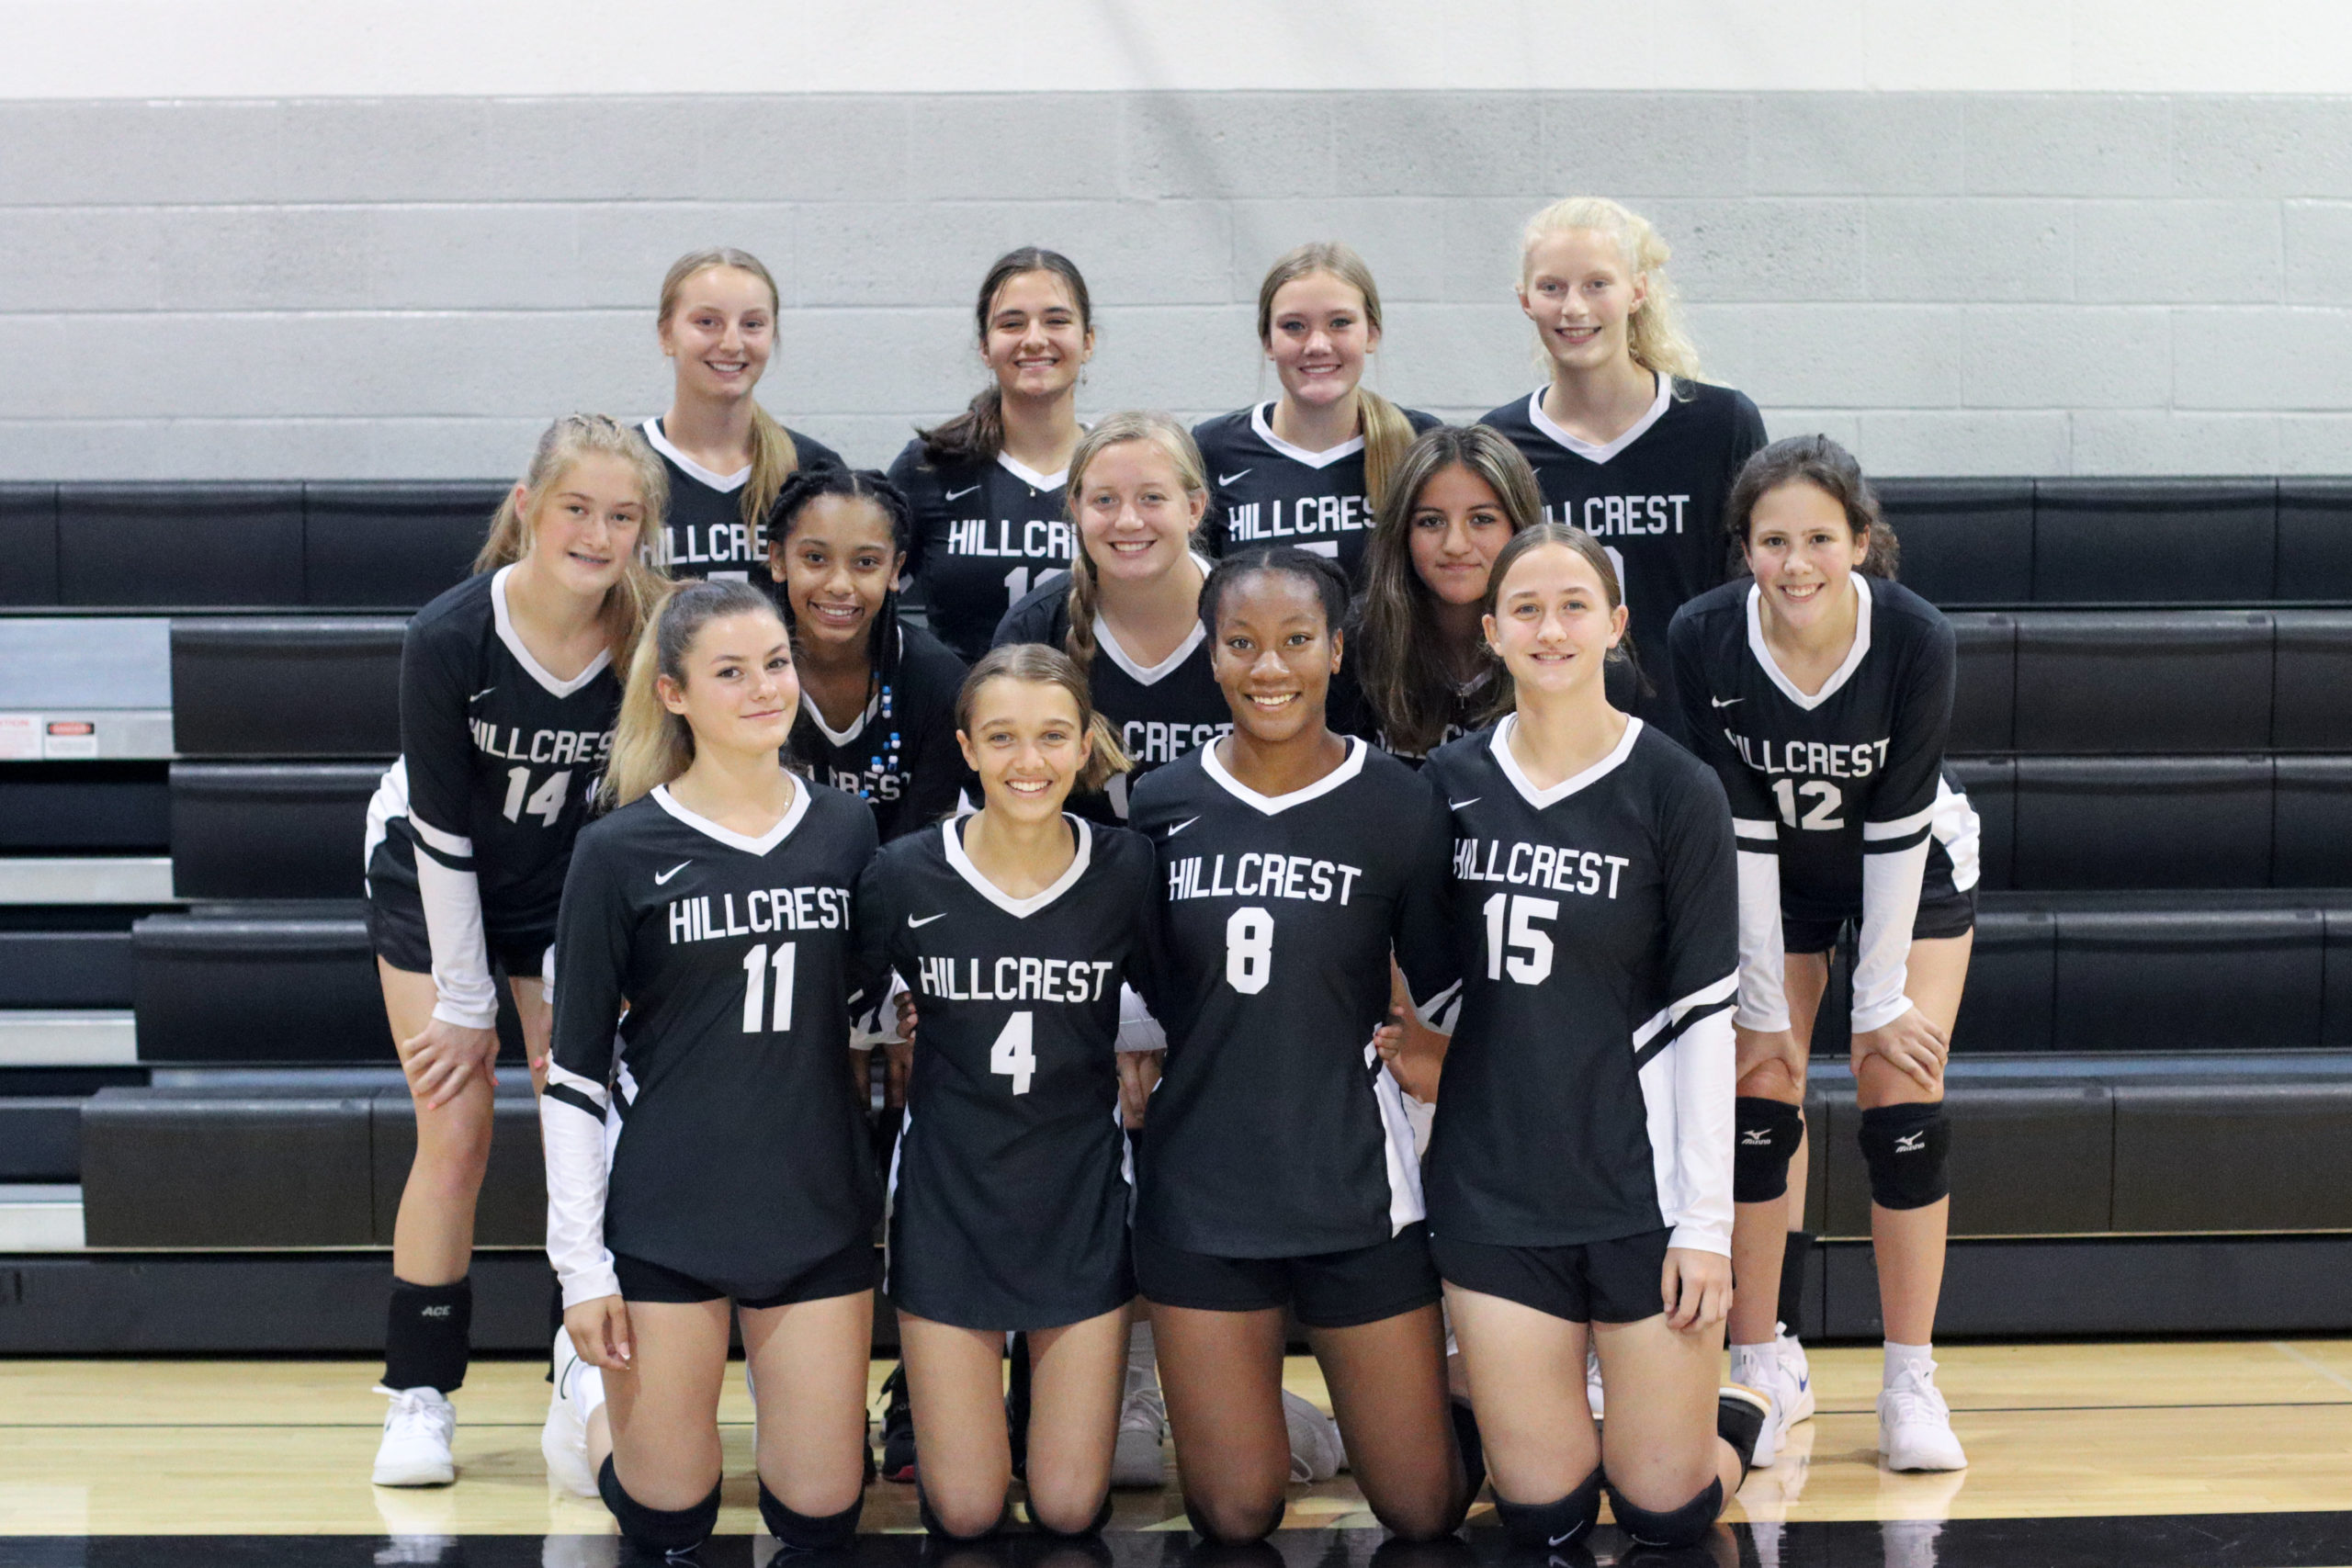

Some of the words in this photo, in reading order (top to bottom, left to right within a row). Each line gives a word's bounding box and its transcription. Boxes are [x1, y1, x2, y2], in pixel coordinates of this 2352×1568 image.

[947, 519, 1081, 559] HILLCR
[1227, 495, 1378, 542] HILLCRES
[469, 716, 616, 764] HILLCRES
[503, 765, 572, 827] 14
[1771, 778, 1845, 830] 12
[1169, 852, 1362, 906] HILLCREST
[1453, 838, 1630, 899] HILLCREST
[669, 886, 851, 943] HILLCREST
[1483, 893, 1560, 986] 15
[919, 956, 1114, 1003] HILLCREST
[1227, 907, 1274, 995] 8
[742, 942, 796, 1033] 11
[990, 1011, 1035, 1096] 4
